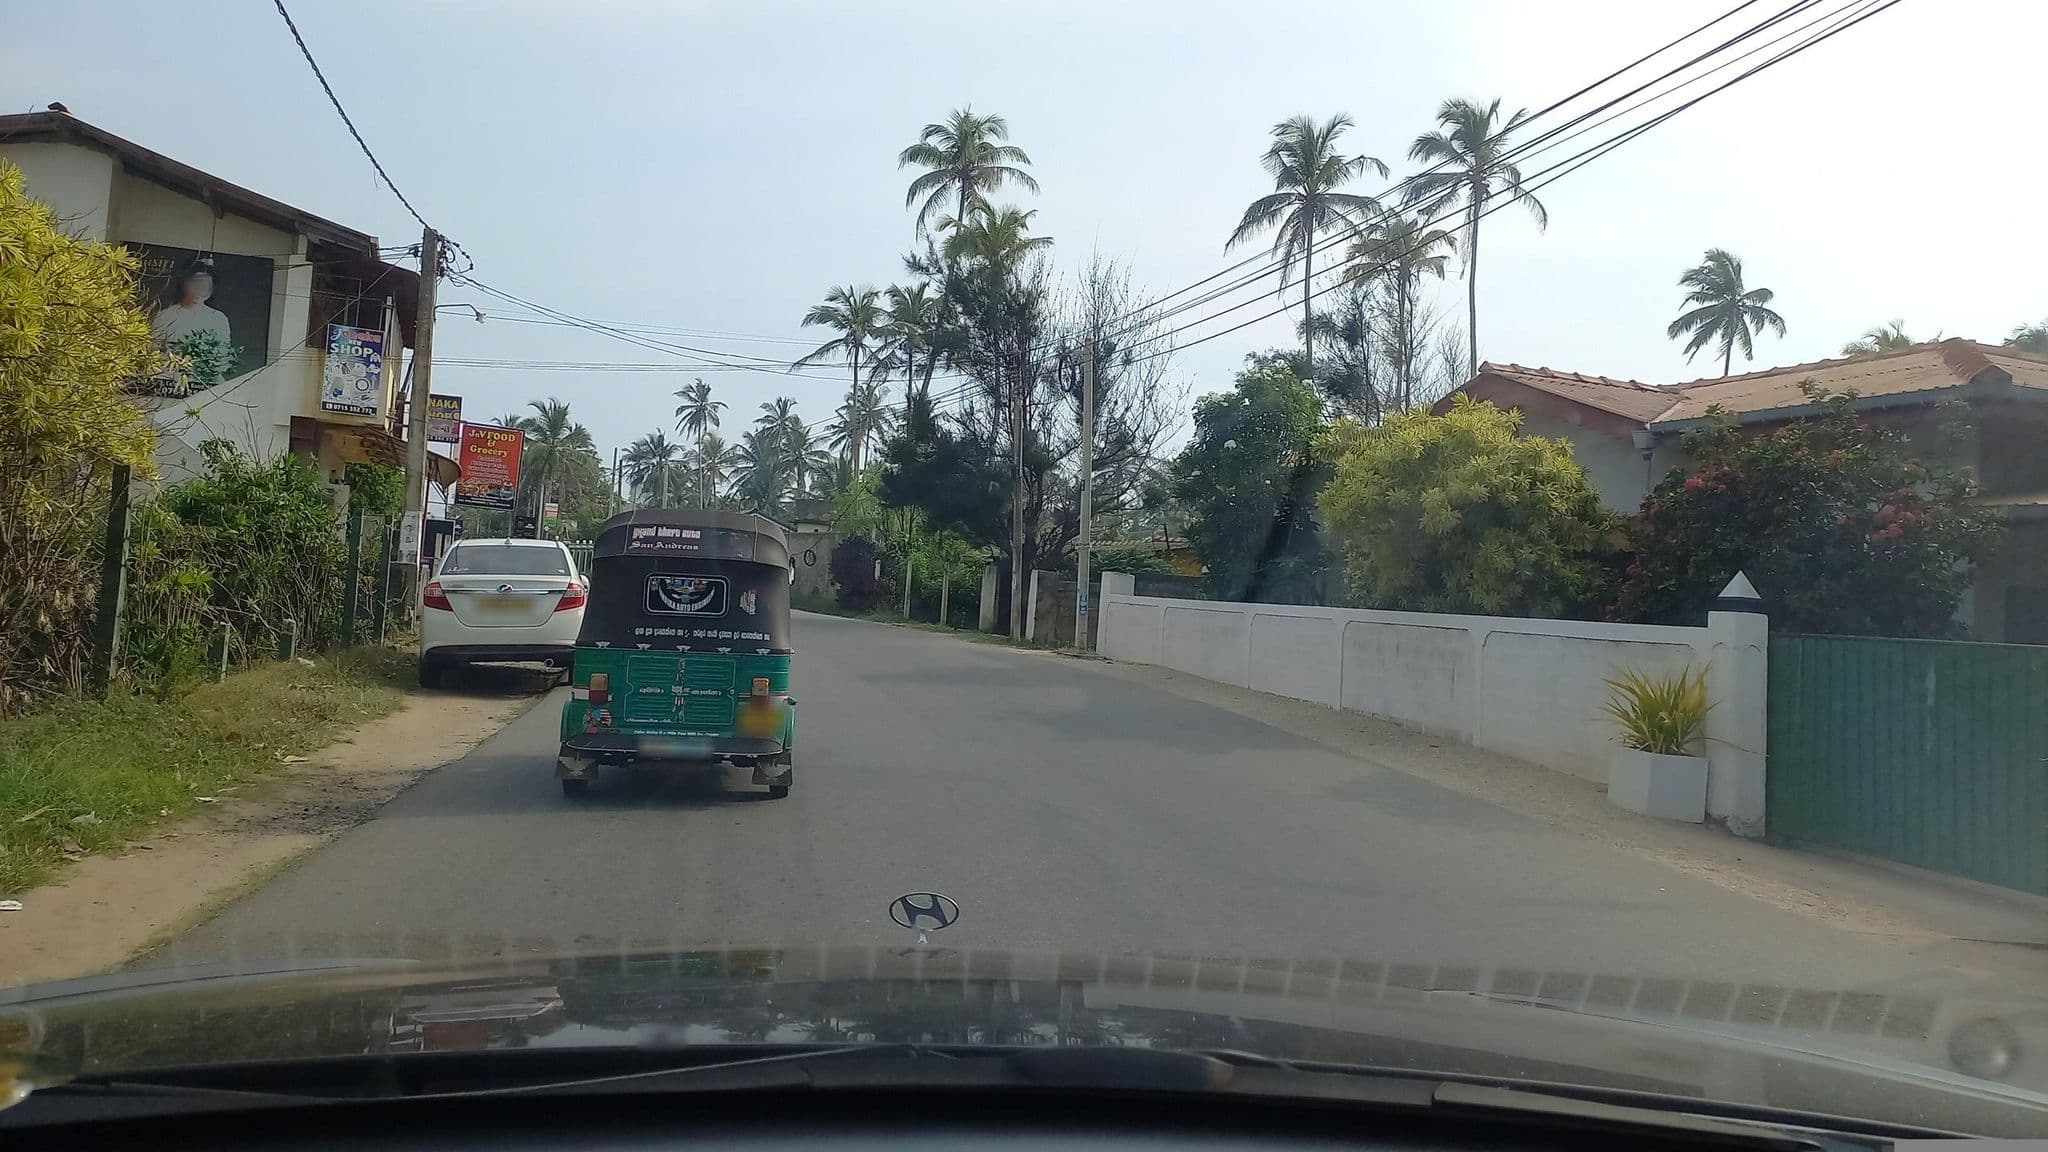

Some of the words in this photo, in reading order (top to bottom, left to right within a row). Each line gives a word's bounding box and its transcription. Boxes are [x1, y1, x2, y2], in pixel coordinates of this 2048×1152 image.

[329, 342, 374, 358] SHOP
[429, 398, 459, 409] NAKA
[429, 410, 451, 419] HOP
[487, 431, 516, 442] FOOD
[469, 444, 510, 458] Grocery
[654, 541, 699, 550] Andreas
